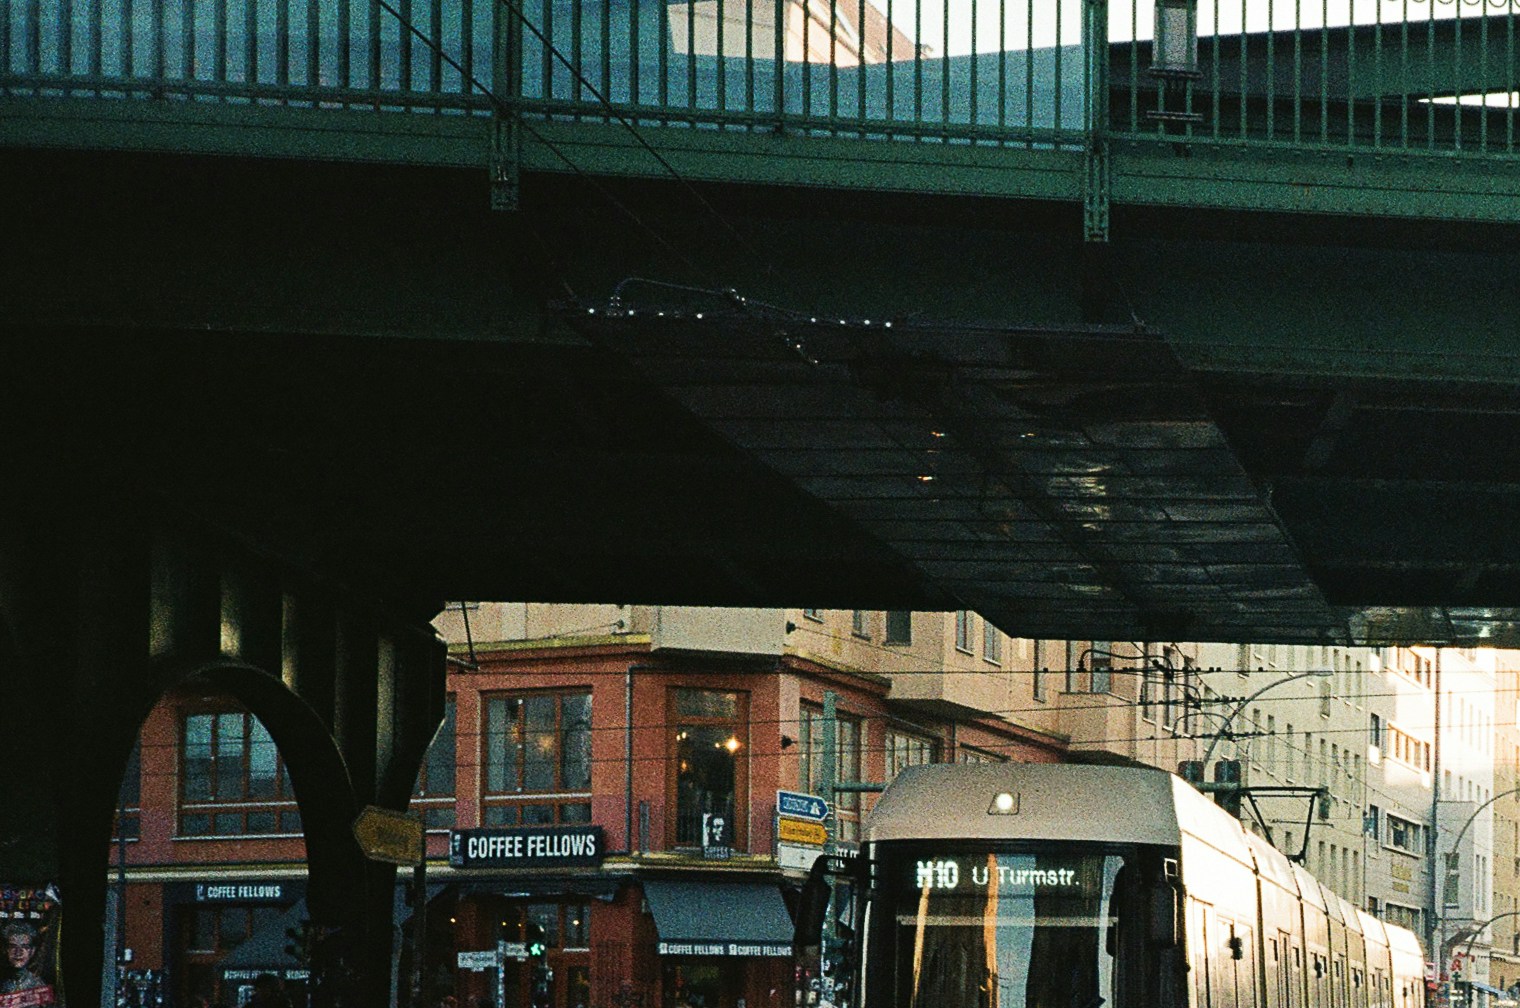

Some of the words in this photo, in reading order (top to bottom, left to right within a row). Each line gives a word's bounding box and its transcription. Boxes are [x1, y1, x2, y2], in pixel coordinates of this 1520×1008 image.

[467, 836, 523, 859] COFFEE
[527, 833, 596, 858] FELLOWS
[916, 860, 959, 889] M10
[972, 865, 989, 886] U
[996, 865, 1080, 886] Turmstr.
[207, 885, 237, 899] COFFEE
[238, 885, 281, 898] FELLOWS
[668, 944, 693, 955] COFFEE
[694, 944, 724, 955] FELLOWS
[737, 945, 761, 956] COFFEE
